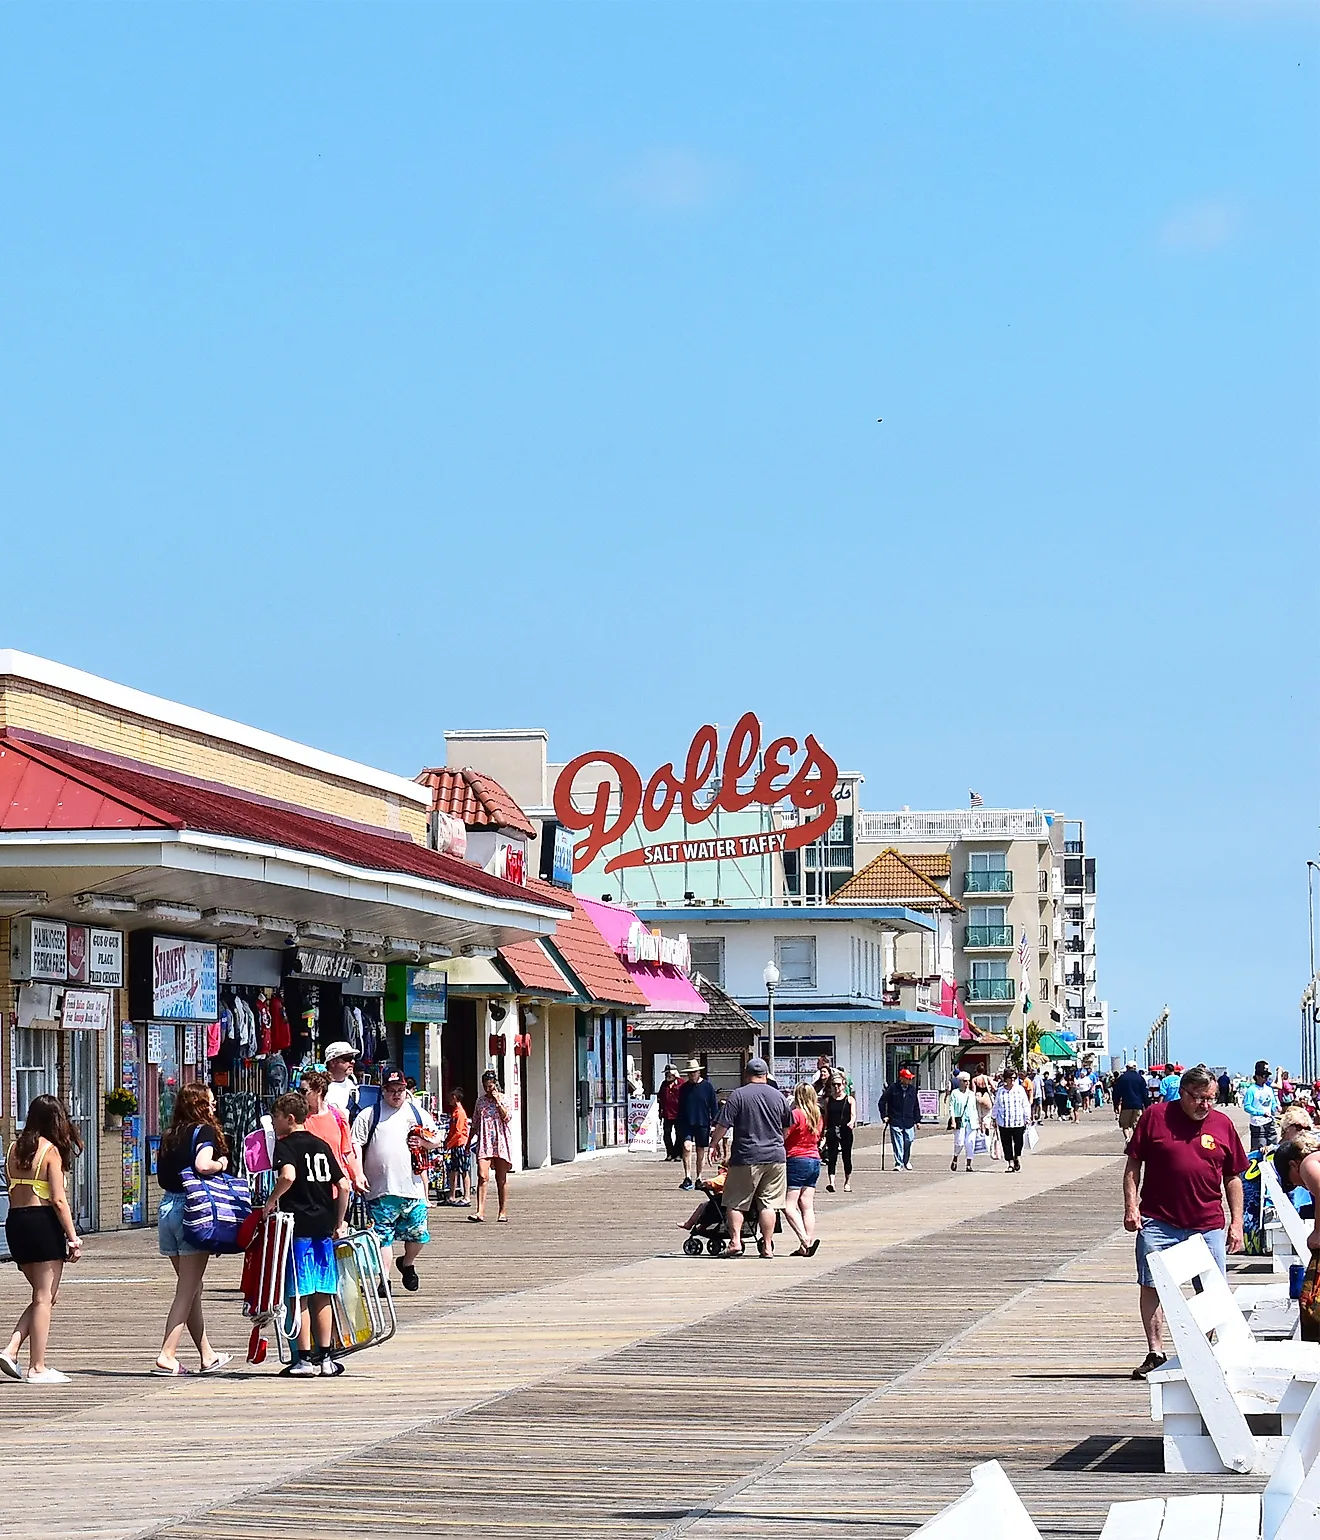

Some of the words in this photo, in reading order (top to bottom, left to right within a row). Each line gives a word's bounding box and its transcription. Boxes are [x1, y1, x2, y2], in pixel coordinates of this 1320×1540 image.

[644, 845, 679, 863] SALT
[682, 839, 736, 860] WATER
[739, 833, 787, 853] TAFFY
[98, 953, 113, 965] PLACE
[304, 1153, 332, 1182] 10
